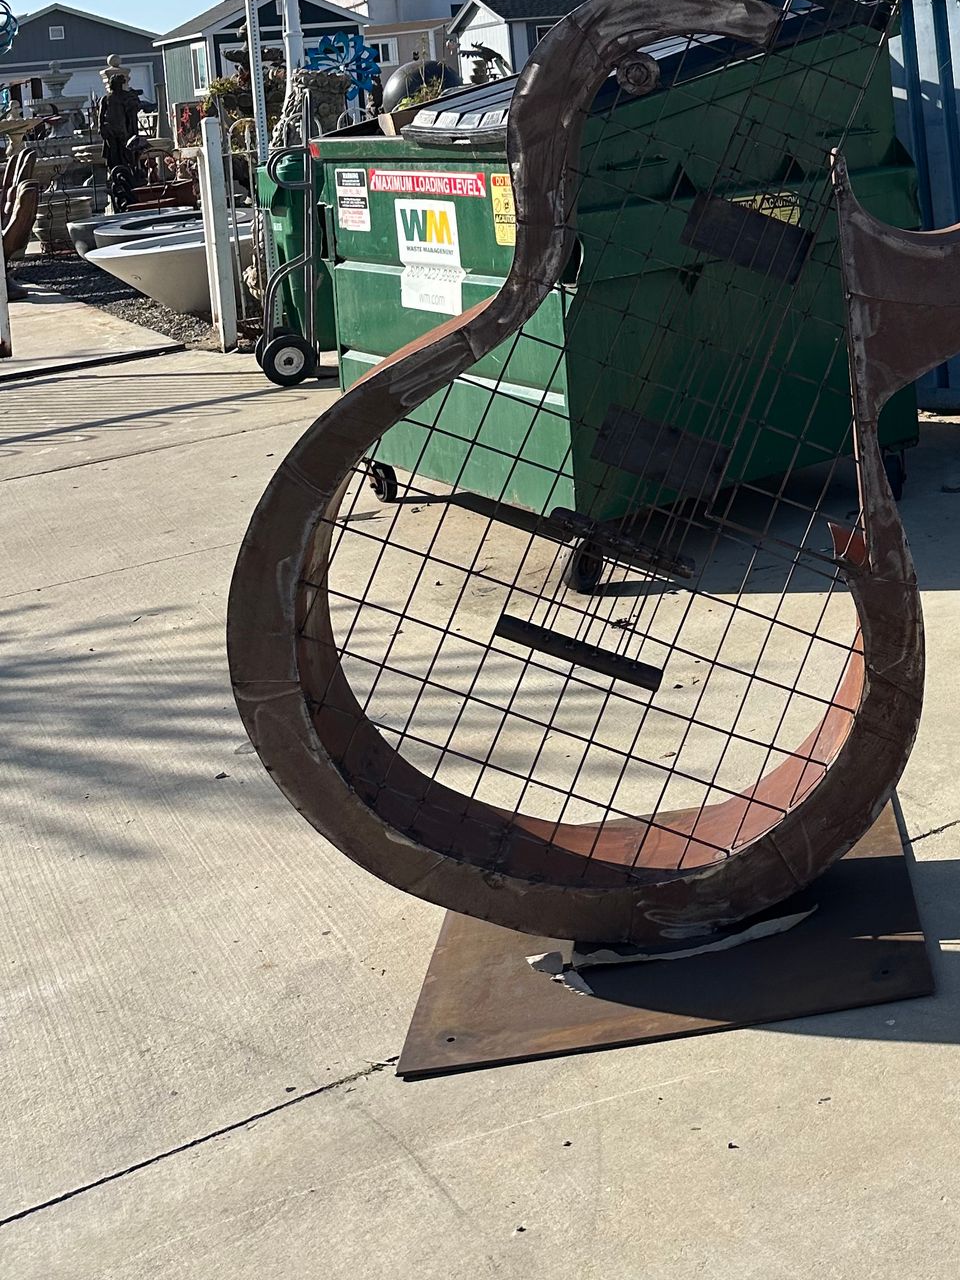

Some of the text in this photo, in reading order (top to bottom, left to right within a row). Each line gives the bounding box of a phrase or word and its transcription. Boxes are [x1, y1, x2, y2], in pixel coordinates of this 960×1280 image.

[375, 175, 413, 191] MAXIMUM
[414, 176, 449, 194] LOADING
[450, 178, 479, 195] LEVEL
[400, 209, 453, 245] WM
[406, 245, 454, 255] WASTE MANAGEMENT
[419, 294, 446, 305] wm.com
